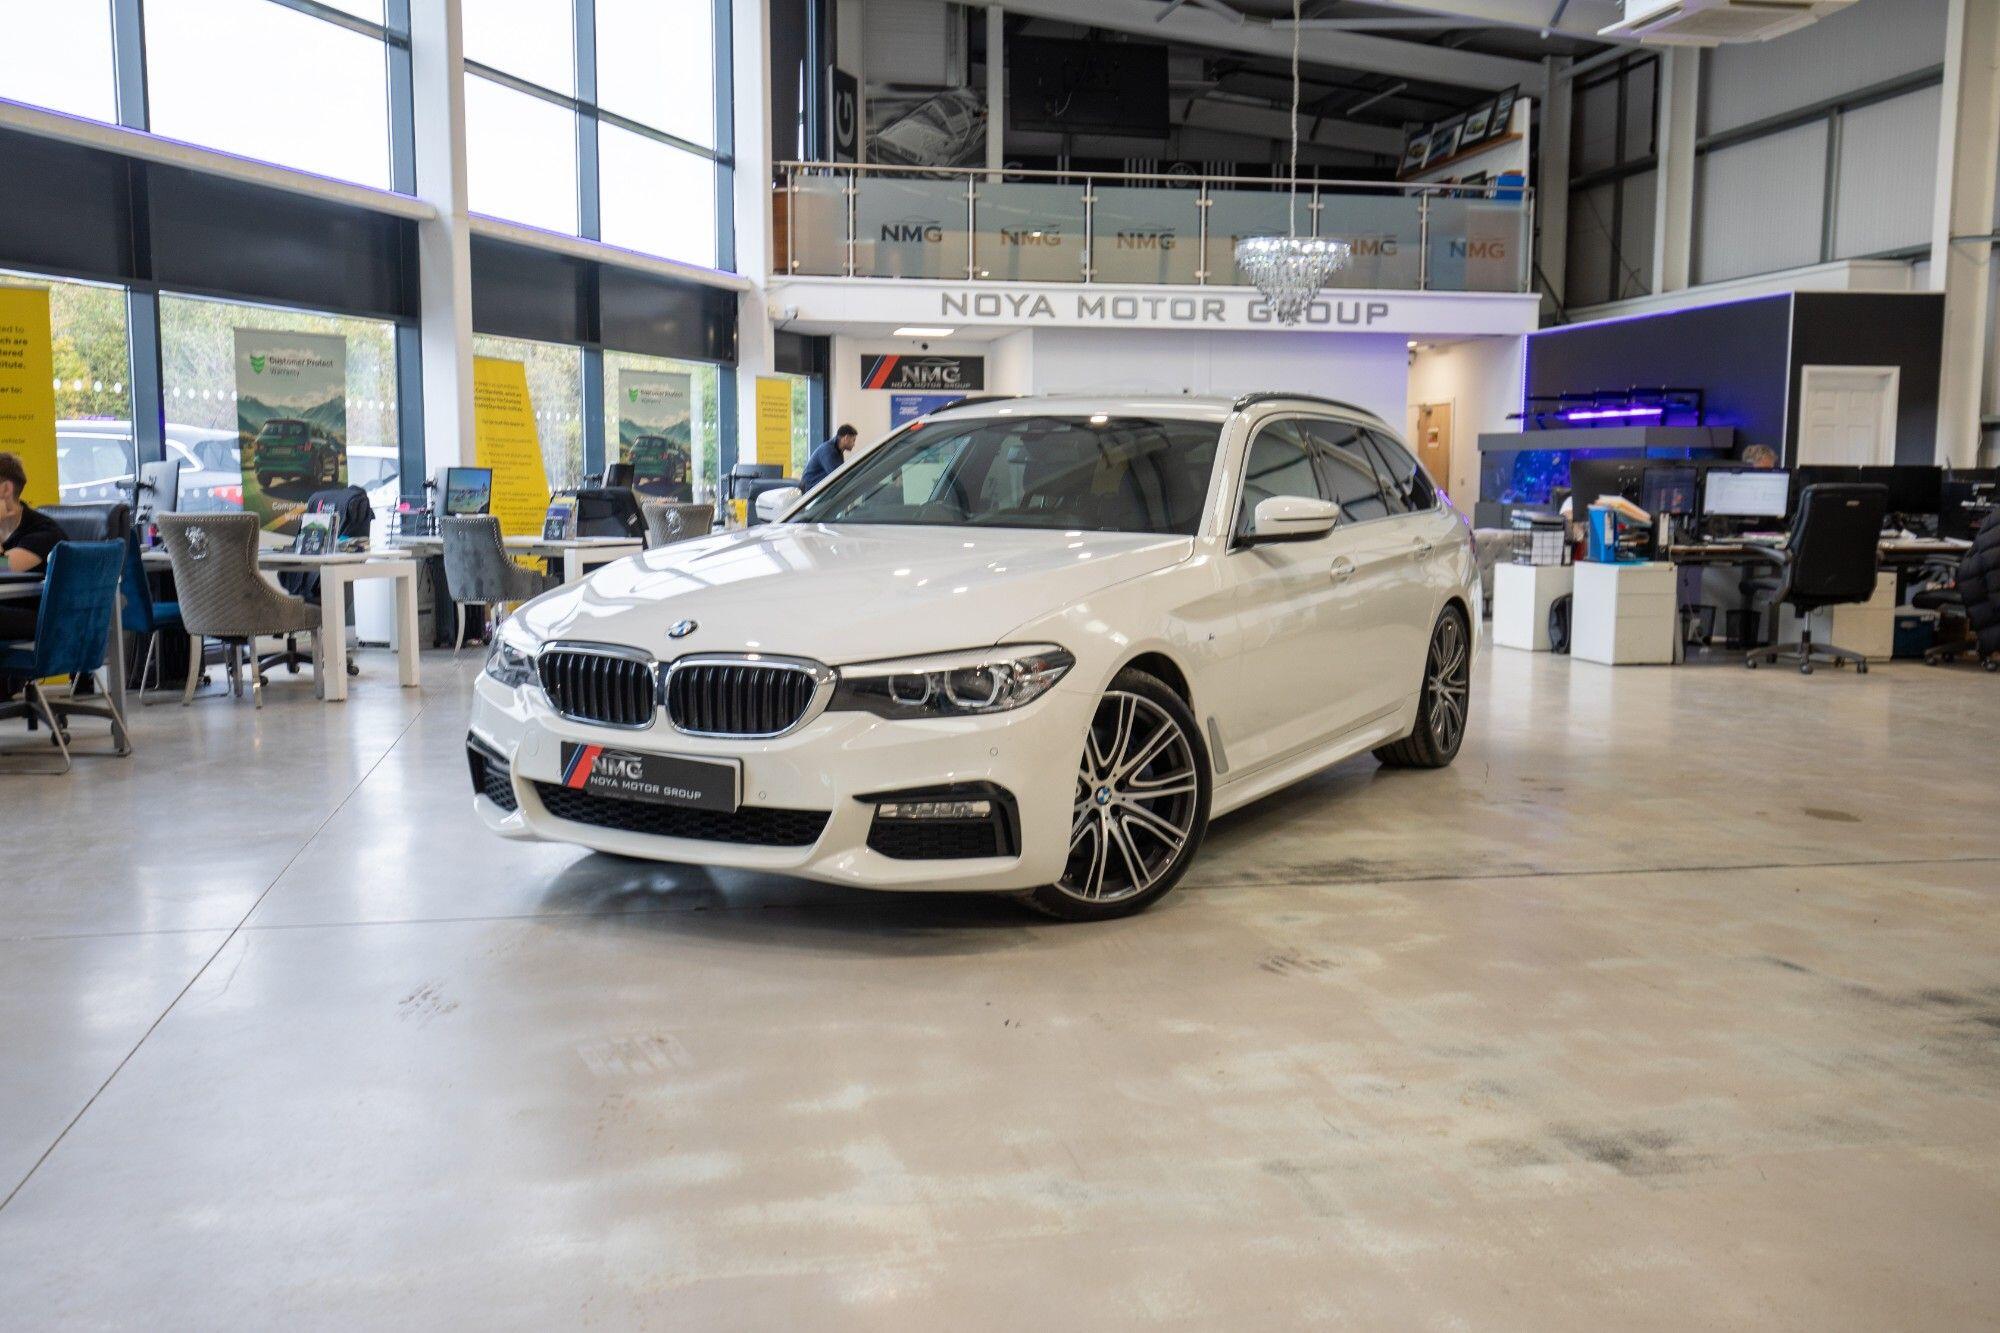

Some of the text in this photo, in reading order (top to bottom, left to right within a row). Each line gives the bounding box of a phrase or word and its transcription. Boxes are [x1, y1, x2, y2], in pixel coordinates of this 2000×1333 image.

[880, 223, 943, 243] NMG
[1000, 227, 1061, 246] NMG
[1116, 231, 1176, 250] NMG
[1450, 241, 1505, 259] NMG
[941, 292, 1389, 325] NOYA MOTOR GOUP
[901, 365, 960, 383] NMG
[590, 755, 643, 780] NMG
[590, 775, 618, 789] NOYA
[622, 780, 660, 795] MOTOR
[663, 785, 701, 800] GROUP
